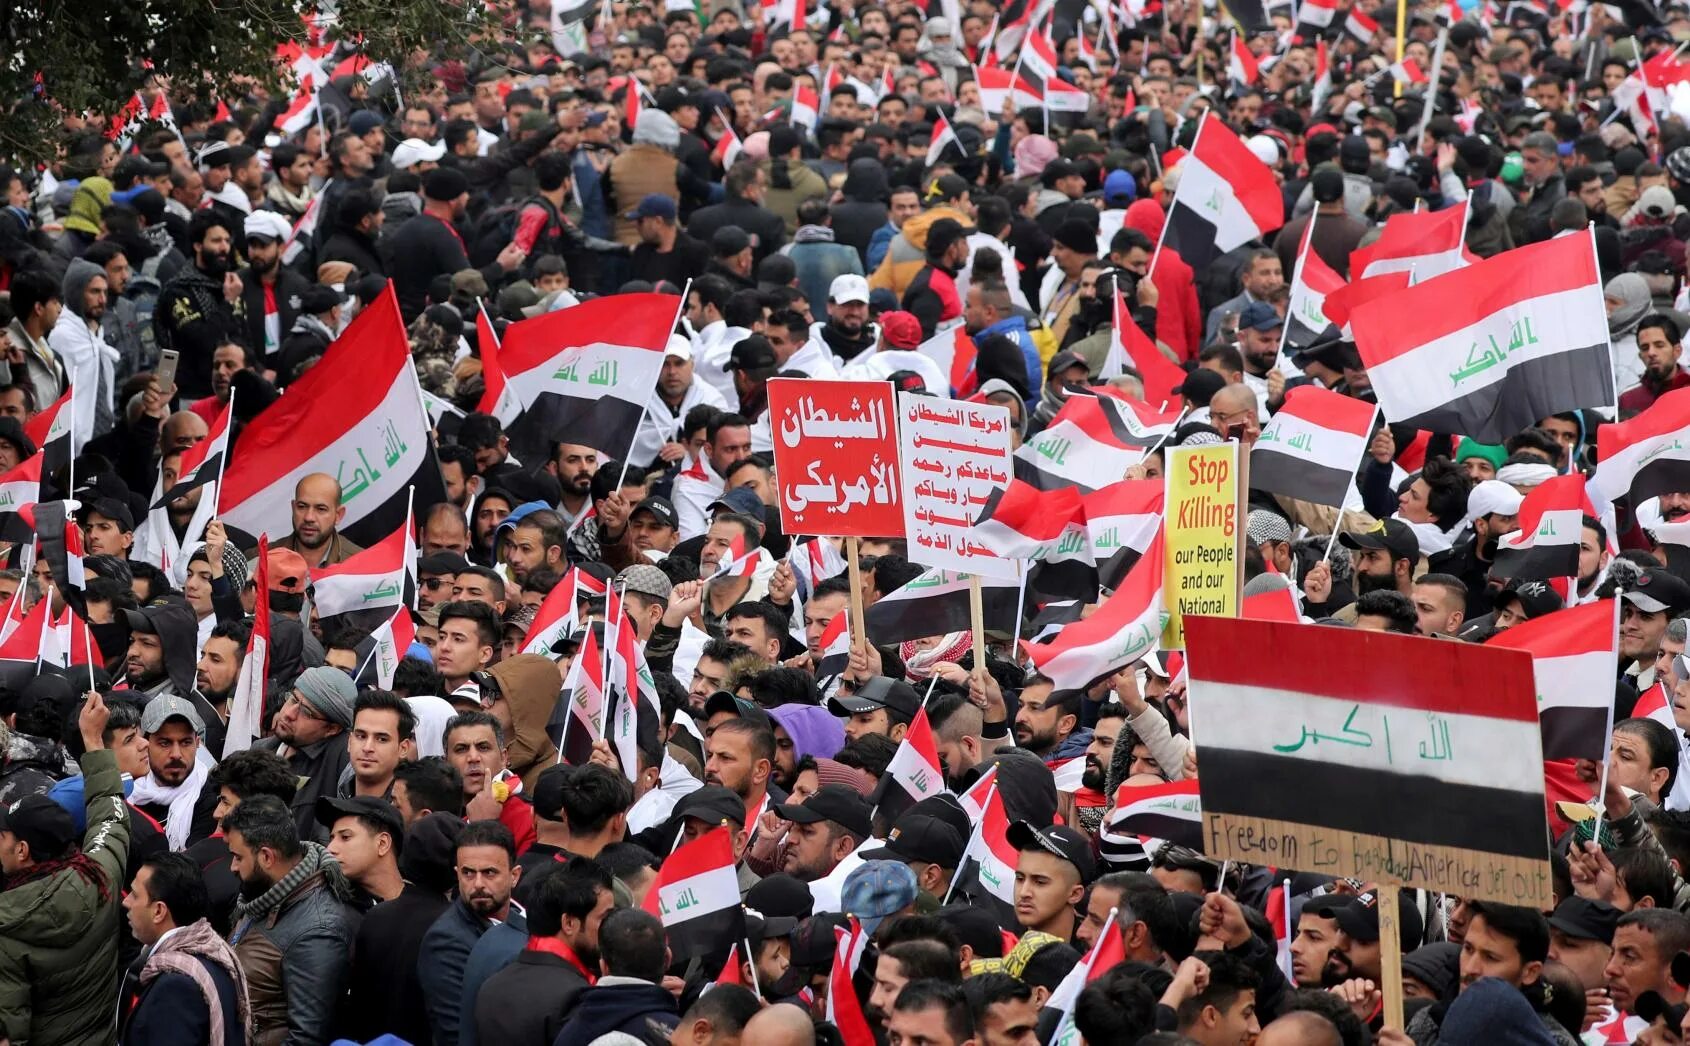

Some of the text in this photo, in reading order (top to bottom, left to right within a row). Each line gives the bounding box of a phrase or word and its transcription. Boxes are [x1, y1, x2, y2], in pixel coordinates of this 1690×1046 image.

[781, 396, 887, 449] الشيطان
[908, 403, 1007, 434] امريكا الشيطان
[337, 447, 382, 505] اك
[785, 453, 897, 522] الأمريكي
[1188, 455, 1229, 492] Stop
[1177, 496, 1235, 537] Killing
[917, 528, 952, 551] الذمة
[1175, 542, 1233, 568] our People
[1181, 570, 1224, 590] and our
[1178, 595, 1226, 616] National
[1418, 711, 1453, 761] الله
[1210, 815, 1298, 860] Freedom
[1309, 831, 1338, 866] to
[1512, 864, 1548, 900] out
